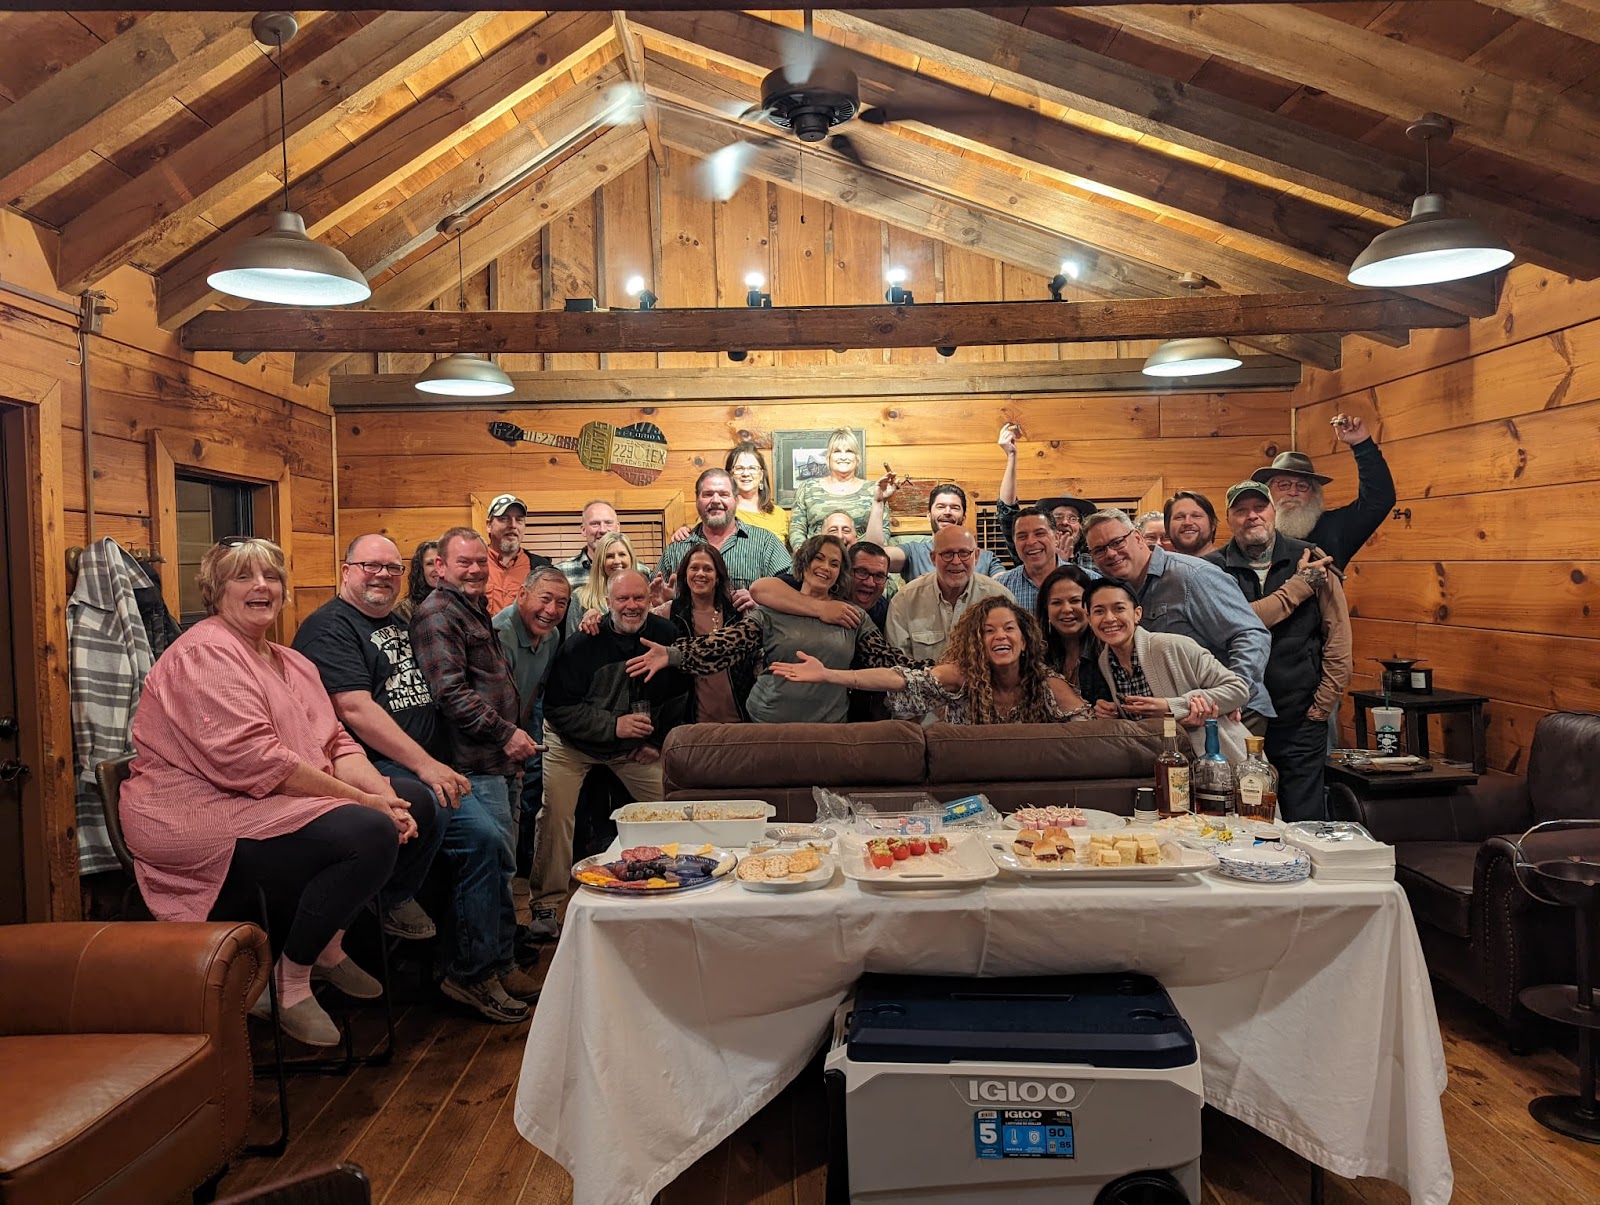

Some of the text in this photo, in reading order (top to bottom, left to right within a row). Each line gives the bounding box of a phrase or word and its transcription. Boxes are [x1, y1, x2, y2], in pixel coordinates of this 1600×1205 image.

[613, 444, 634, 458] 229
[394, 686, 415, 698] THE
[969, 1080, 1075, 1103] IGLOO
[1004, 1110, 1042, 1119] IGLOO
[979, 1122, 998, 1145] 5
[1048, 1128, 1065, 1138] 90
[1059, 1141, 1071, 1149] 85
